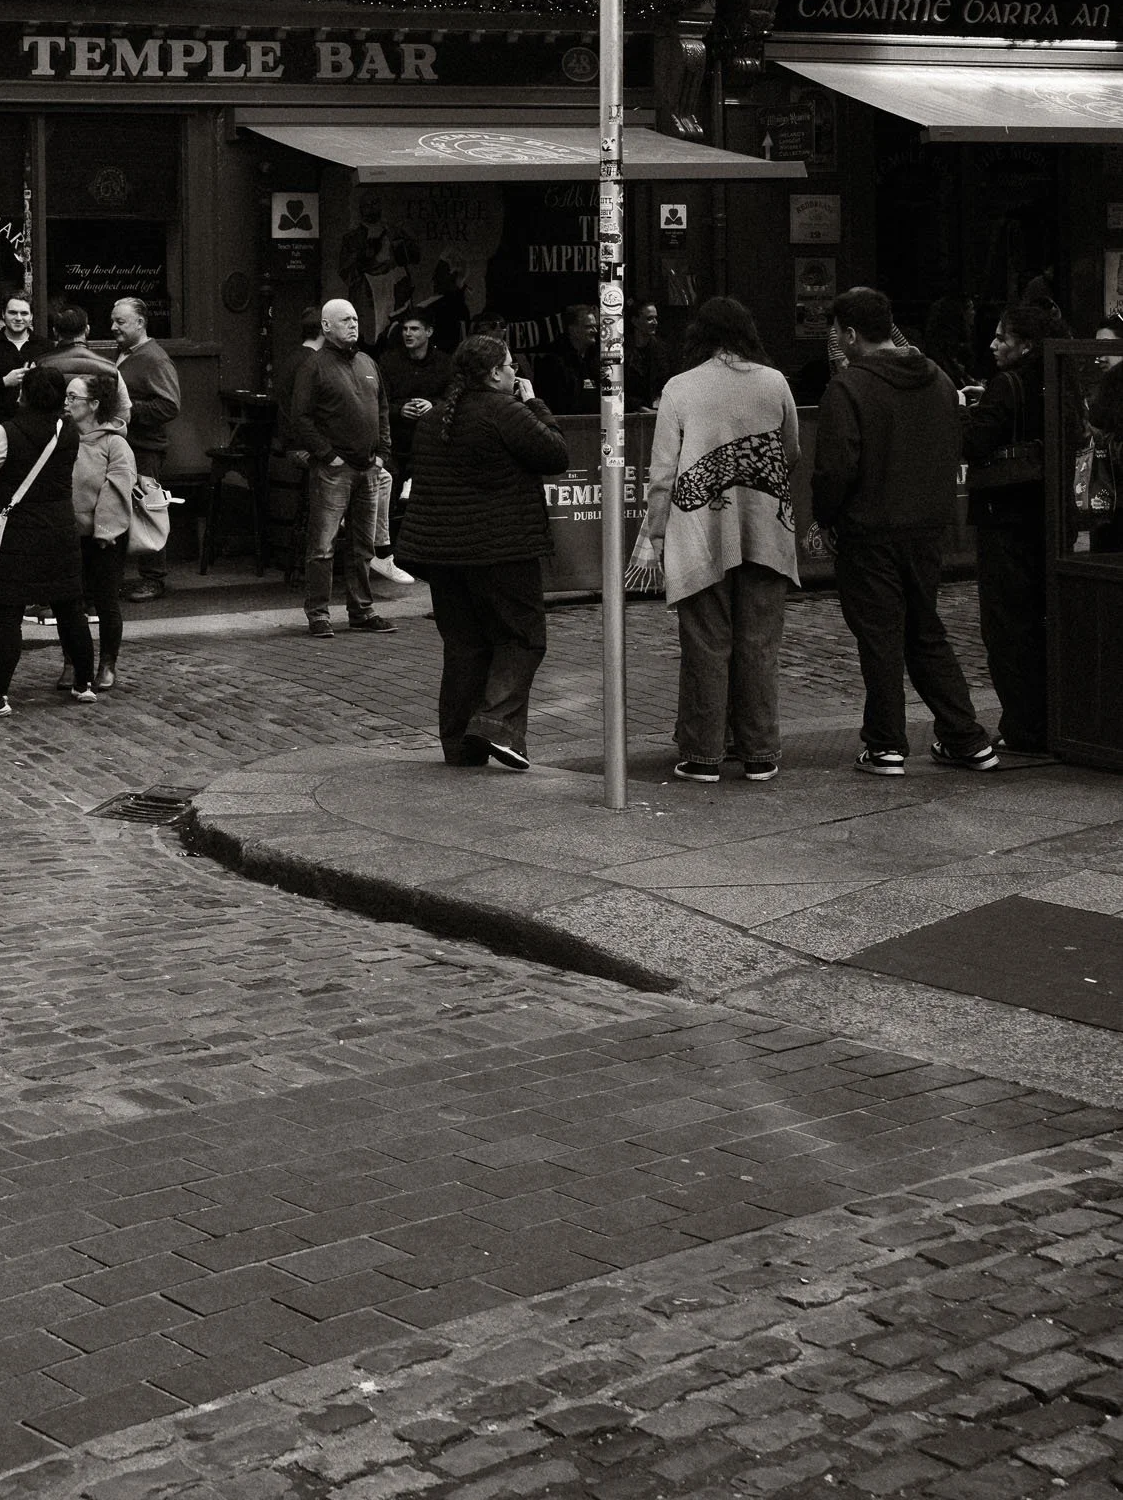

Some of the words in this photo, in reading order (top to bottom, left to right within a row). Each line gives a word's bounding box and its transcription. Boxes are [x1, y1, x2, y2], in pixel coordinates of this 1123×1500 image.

[22, 35, 286, 79] TEMPLE
[316, 41, 439, 81] BAR
[528, 245, 599, 272] EMPER
[93, 264, 116, 275] lived
[116, 264, 134, 275] and
[135, 264, 163, 275] loved
[64, 280, 84, 290] and
[121, 280, 139, 290] and
[543, 483, 637, 506] TEMPE
[574, 511, 602, 520] DUBLI
